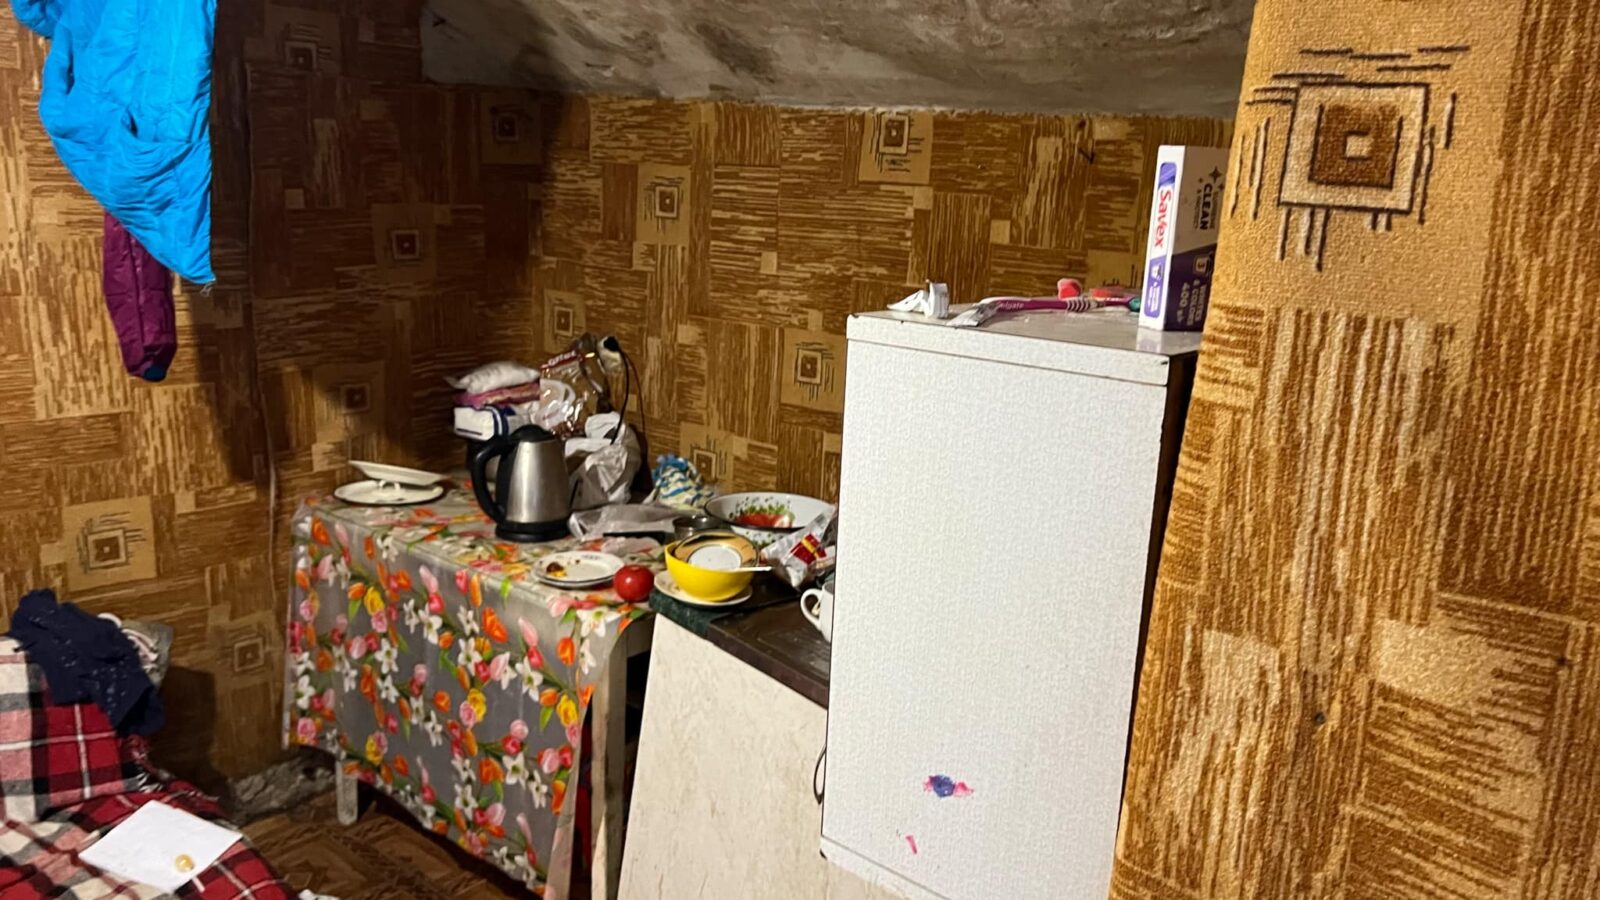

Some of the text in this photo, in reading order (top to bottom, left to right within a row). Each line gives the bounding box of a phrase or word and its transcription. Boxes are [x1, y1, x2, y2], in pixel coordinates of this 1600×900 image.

[1154, 191, 1171, 247] Savex
[1200, 183, 1213, 230] CLEAN
[1179, 282, 1190, 308] 400
